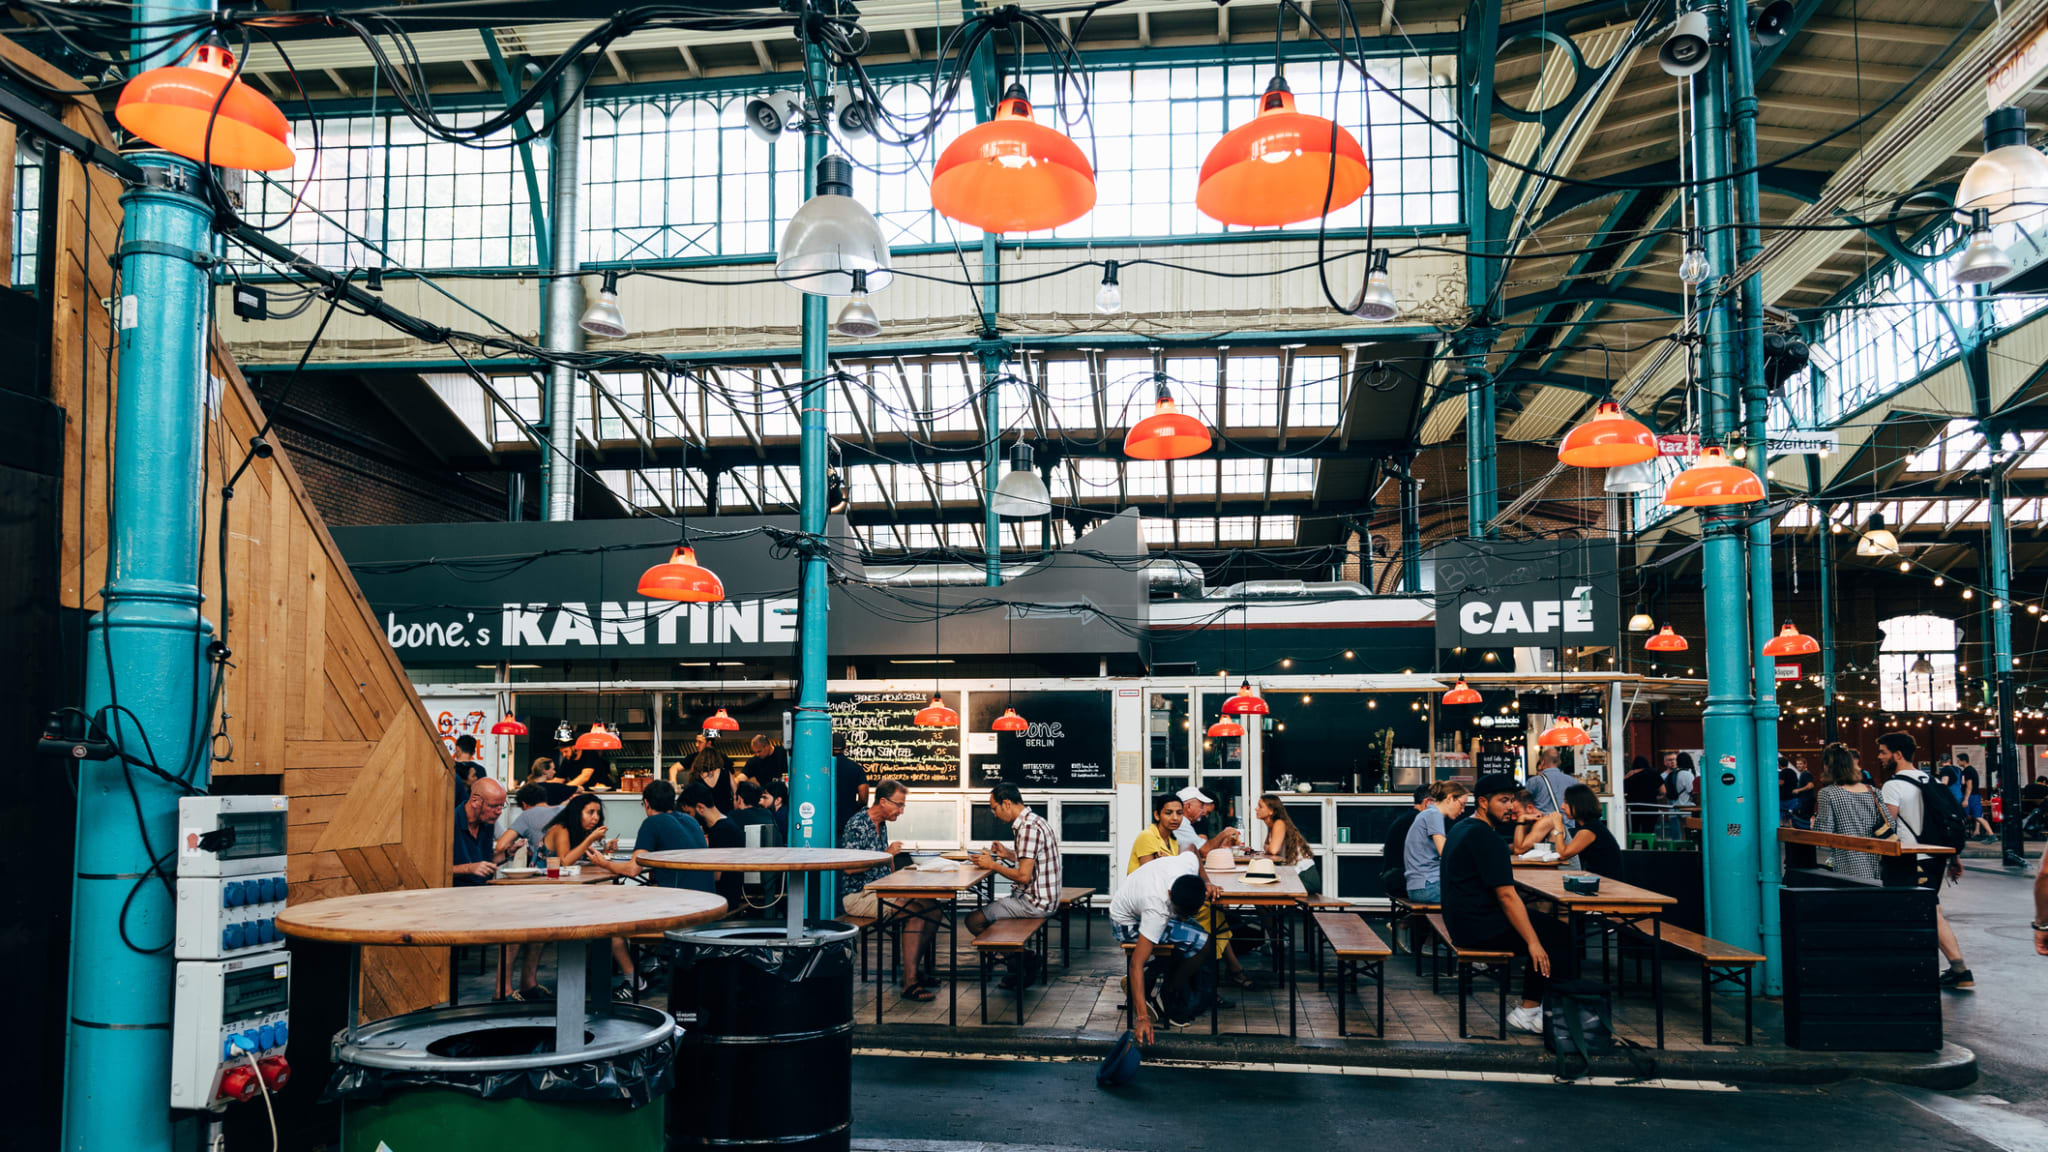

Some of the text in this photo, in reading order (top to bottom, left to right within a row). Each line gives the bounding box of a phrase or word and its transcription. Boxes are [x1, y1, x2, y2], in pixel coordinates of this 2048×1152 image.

[1658, 440, 1684, 453] taz
[1767, 436, 1833, 450] szeitung
[1459, 586, 1594, 635] CAFÉ
[502, 599, 798, 646] KANTINE
[1025, 739, 1055, 747] BERLIN
